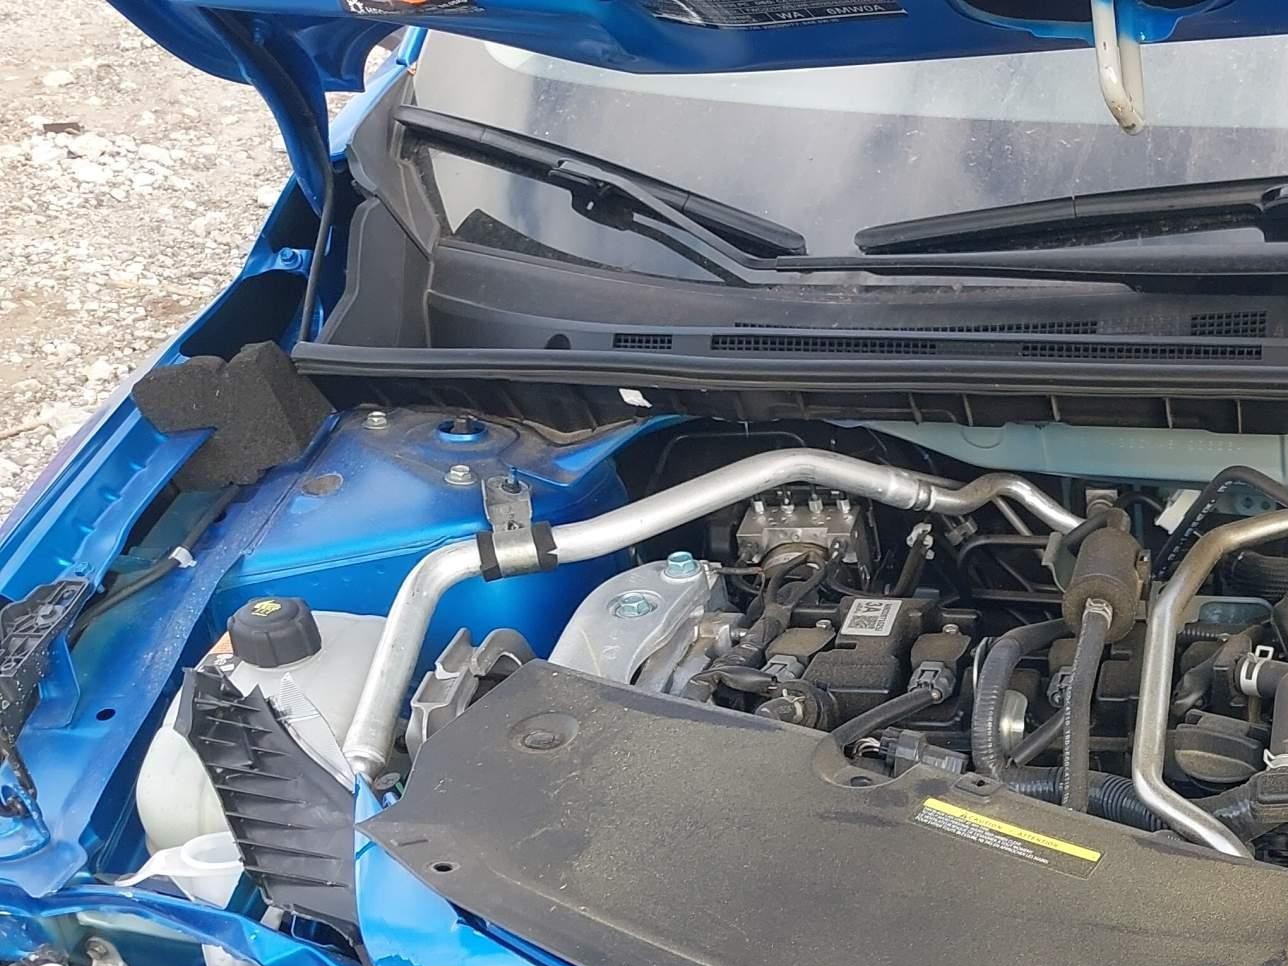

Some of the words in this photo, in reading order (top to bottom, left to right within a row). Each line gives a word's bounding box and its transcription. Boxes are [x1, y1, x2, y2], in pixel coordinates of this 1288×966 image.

[776, 11, 805, 20] WA
[967, 815, 1003, 829] CAUTION
[1018, 831, 1059, 847] ATTENTION
